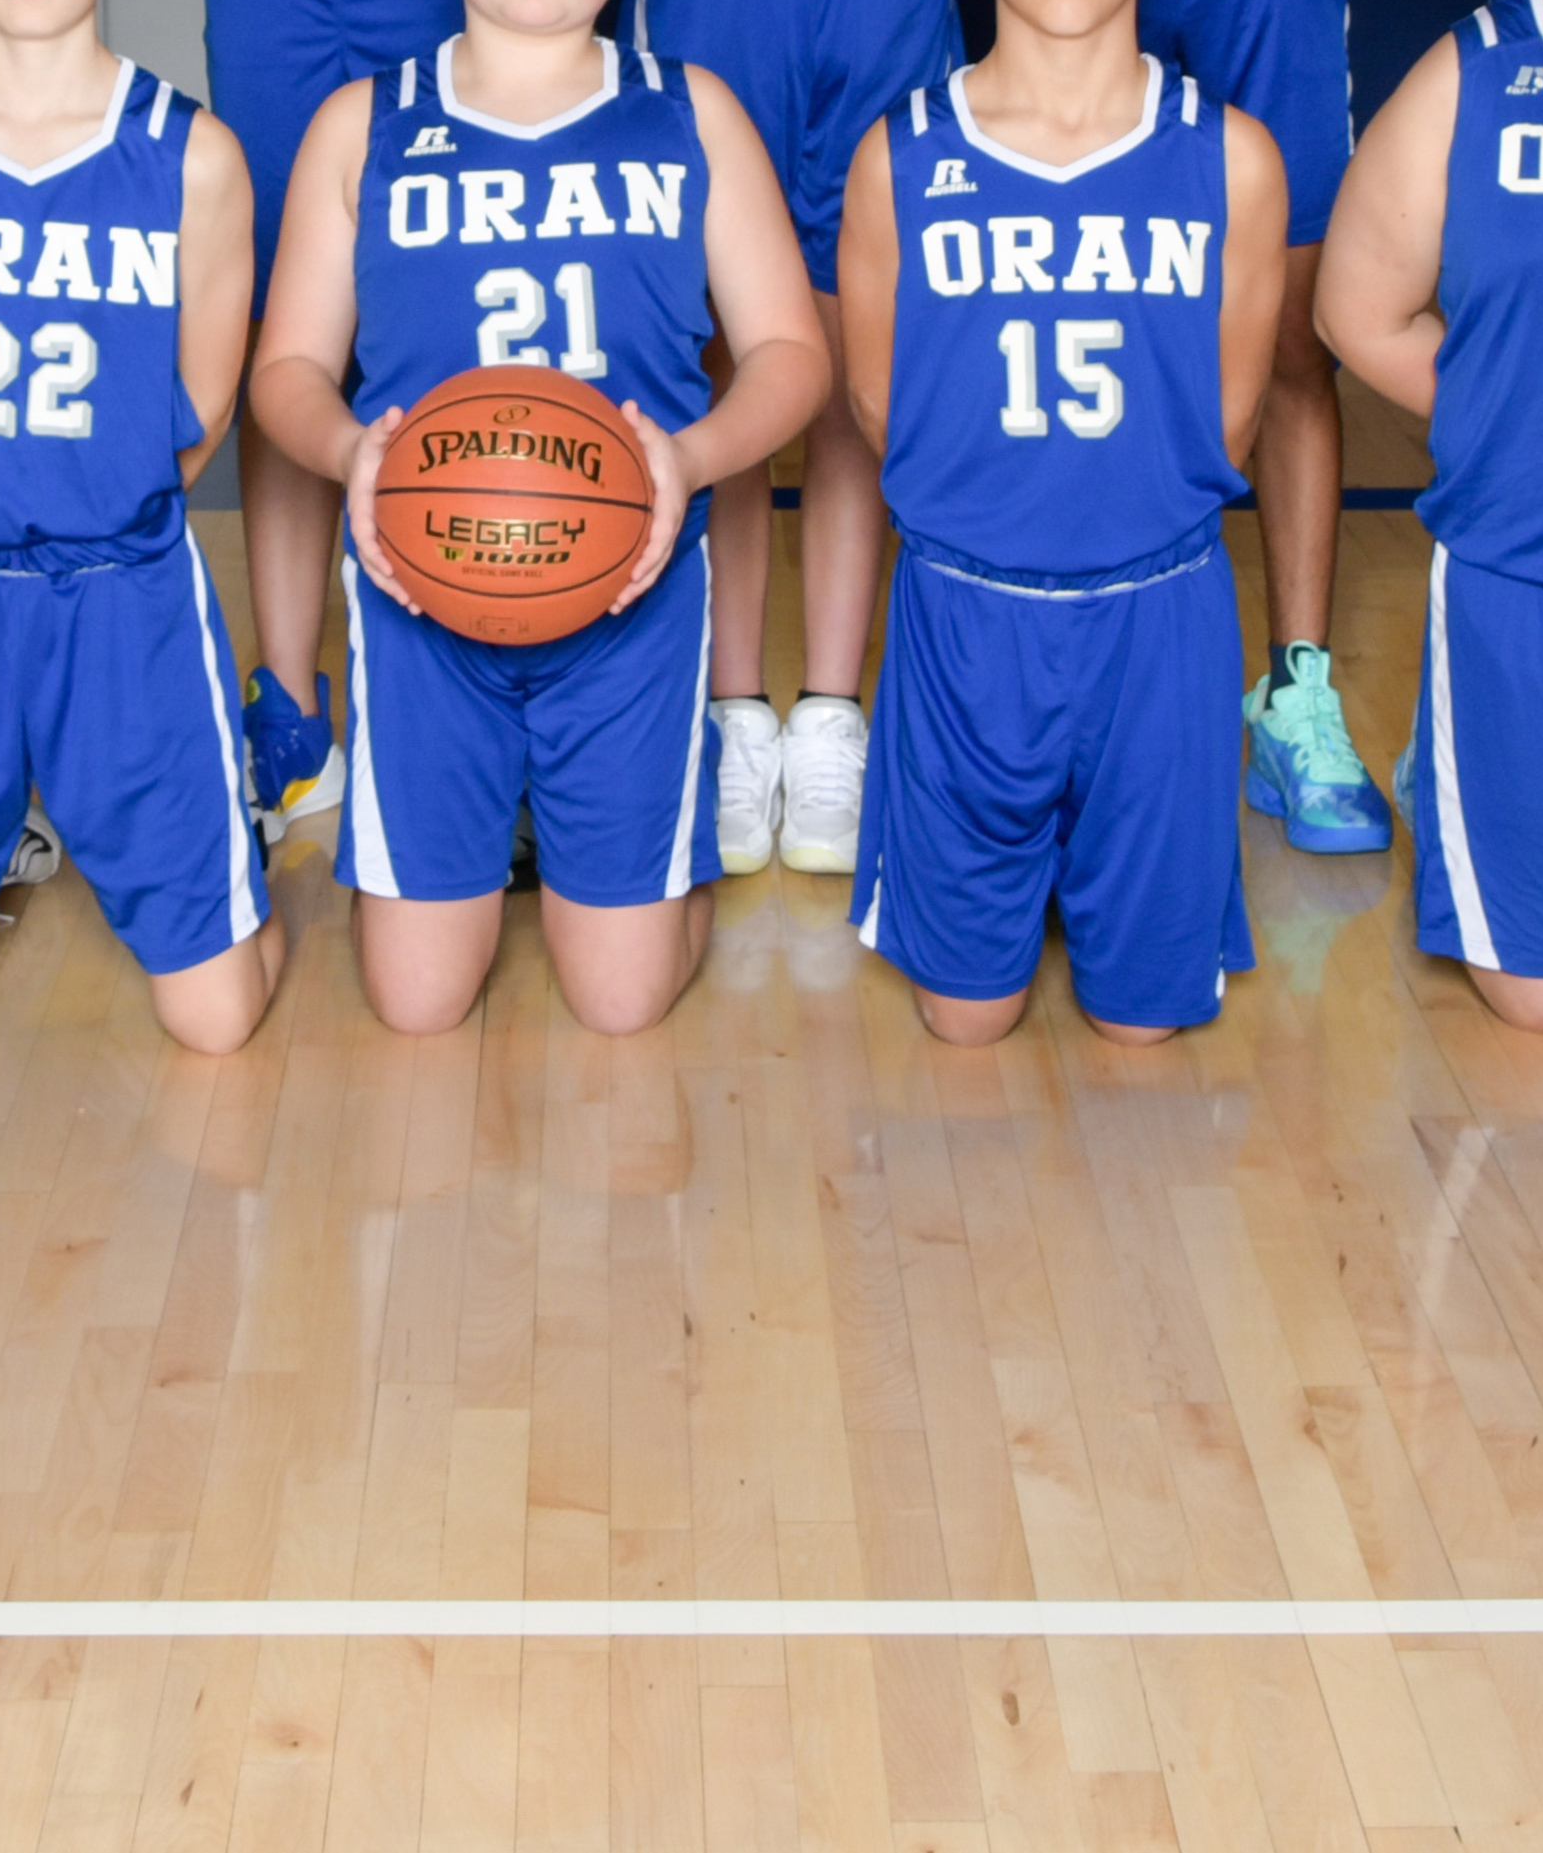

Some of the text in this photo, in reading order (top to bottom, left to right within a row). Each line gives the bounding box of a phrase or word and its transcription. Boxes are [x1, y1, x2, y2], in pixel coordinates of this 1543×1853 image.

[388, 161, 688, 249] ORAN
[920, 214, 1212, 298] ORAN
[474, 261, 608, 381] 21
[997, 319, 1125, 439] 15
[418, 429, 603, 484] SPALDING
[425, 509, 586, 546] LEGACY
